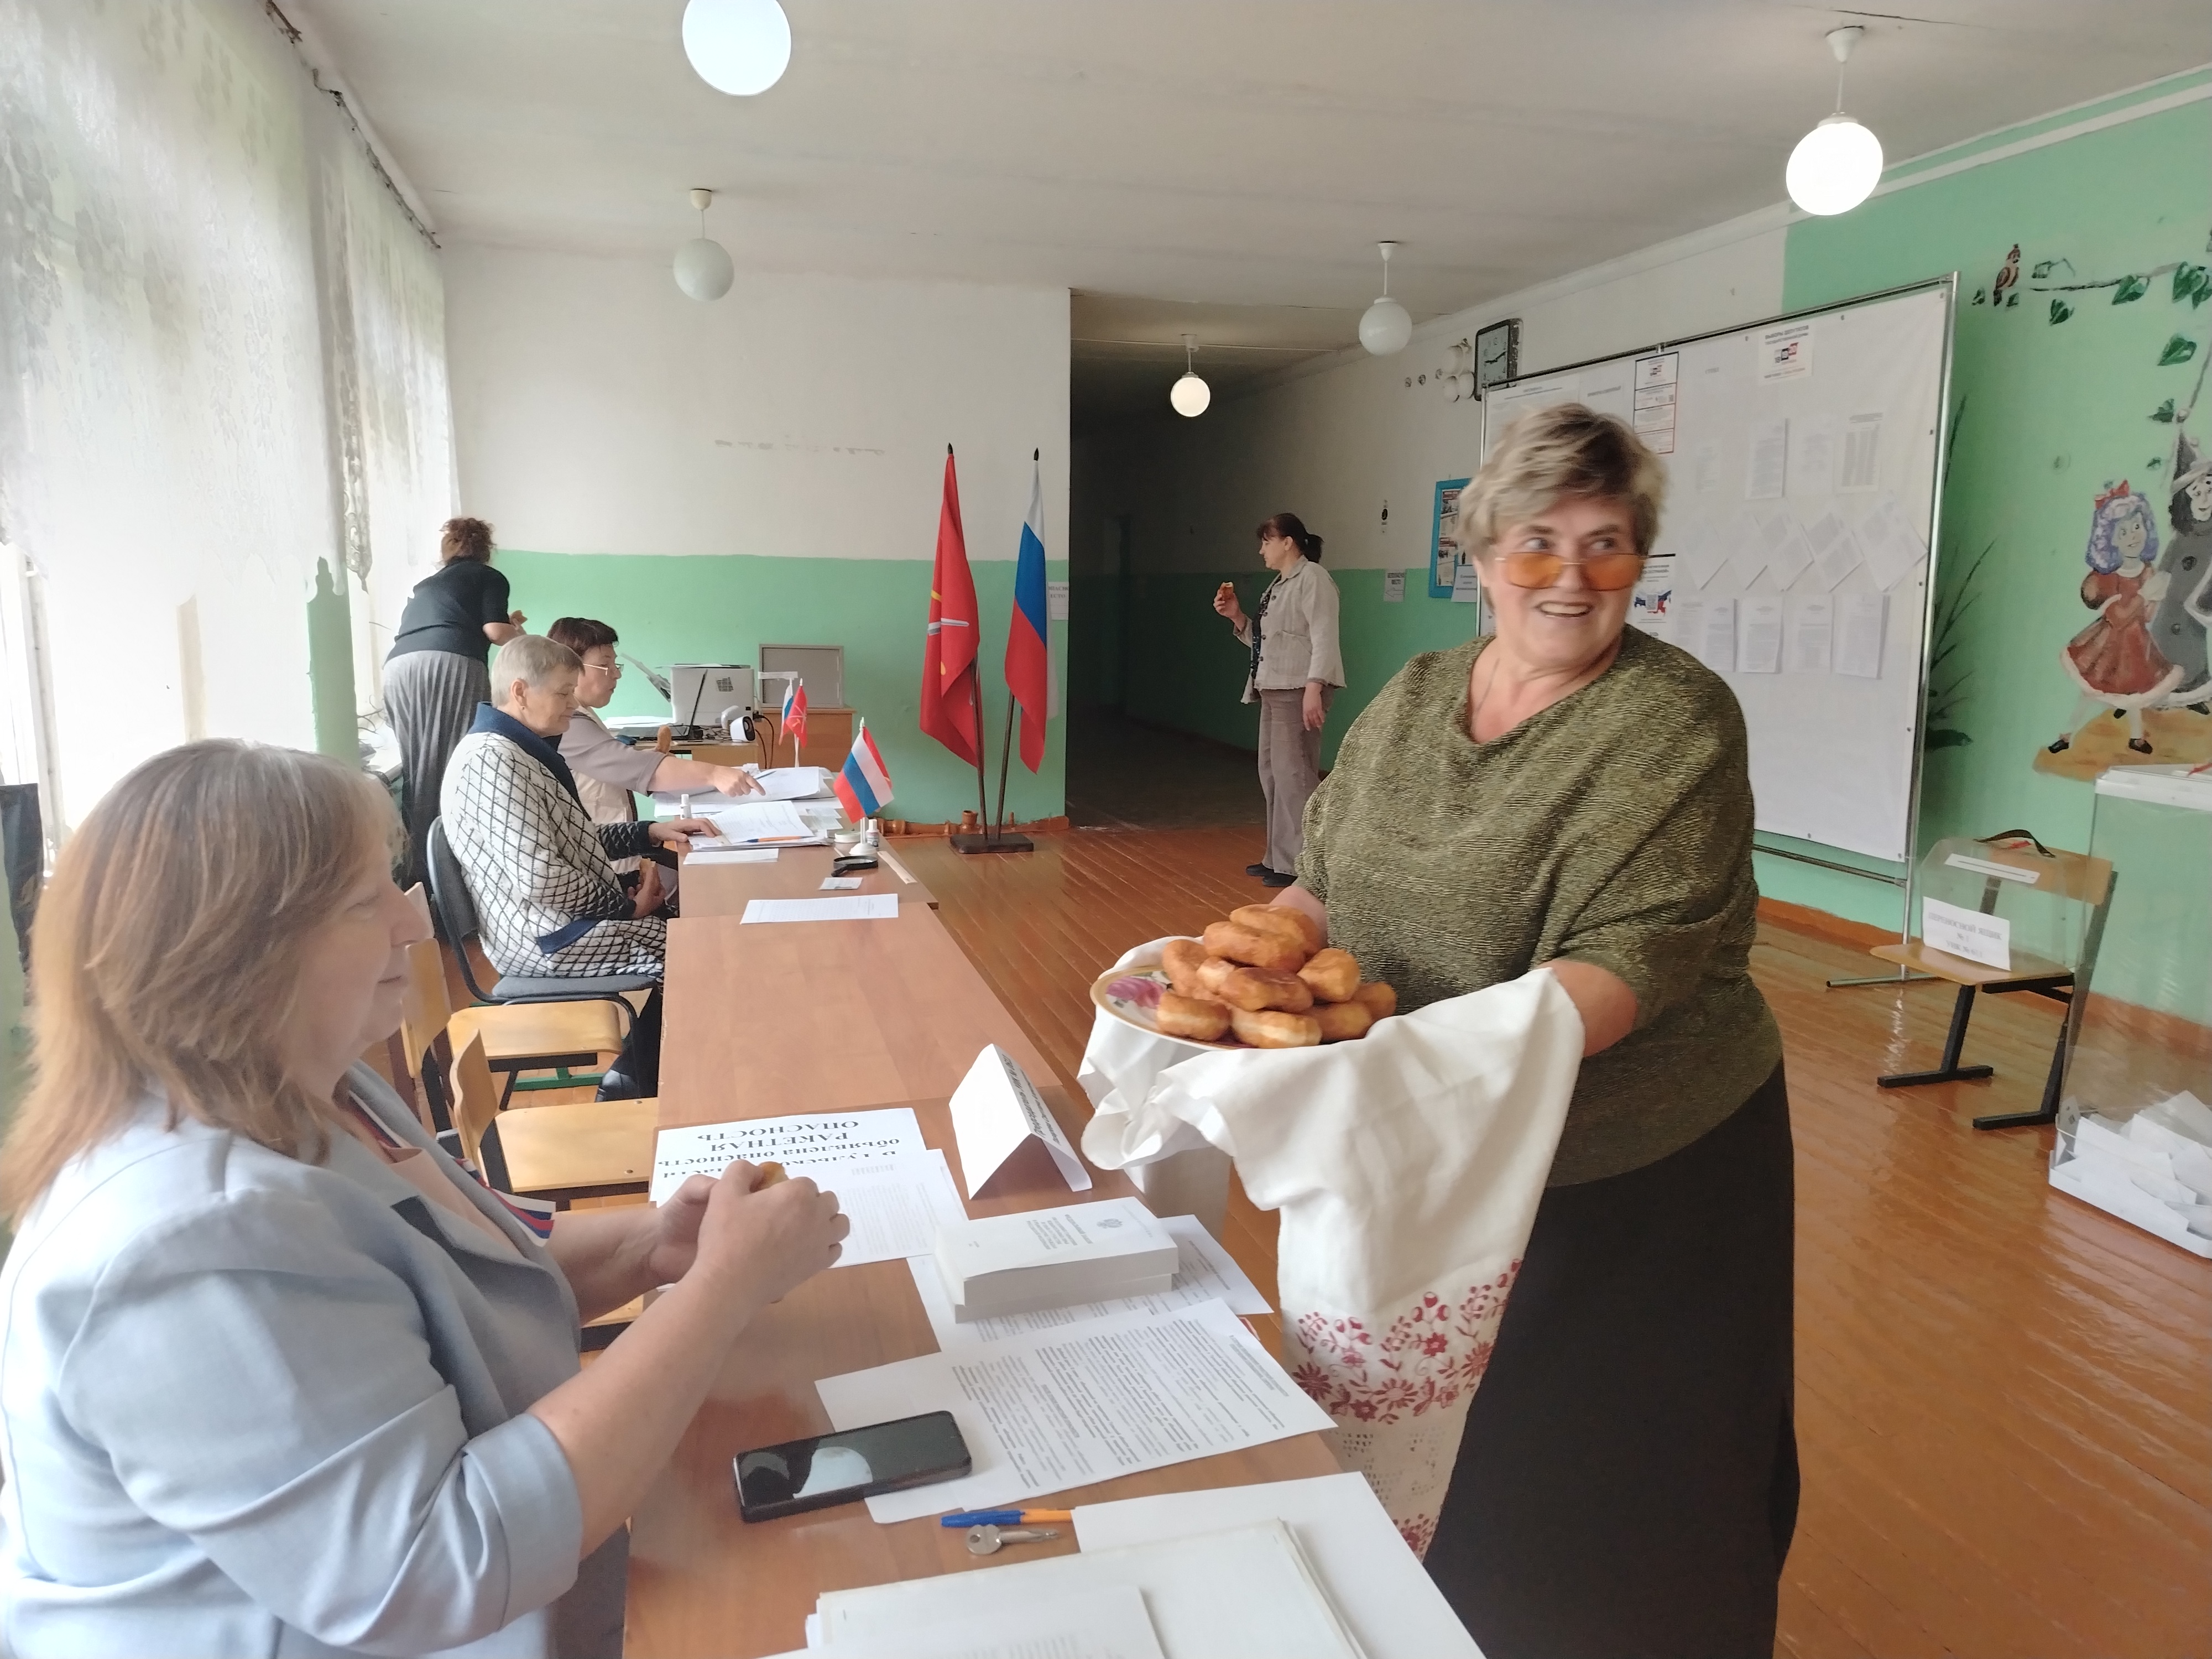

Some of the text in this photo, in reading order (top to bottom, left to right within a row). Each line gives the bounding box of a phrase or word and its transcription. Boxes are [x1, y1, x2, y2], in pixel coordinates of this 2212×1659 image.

[697, 1121, 859, 1141] ОПАСНОСТЬ
[711, 1133, 848, 1151] РАКЕТНАЯ
[658, 1139, 900, 1166] объявлена опасность
